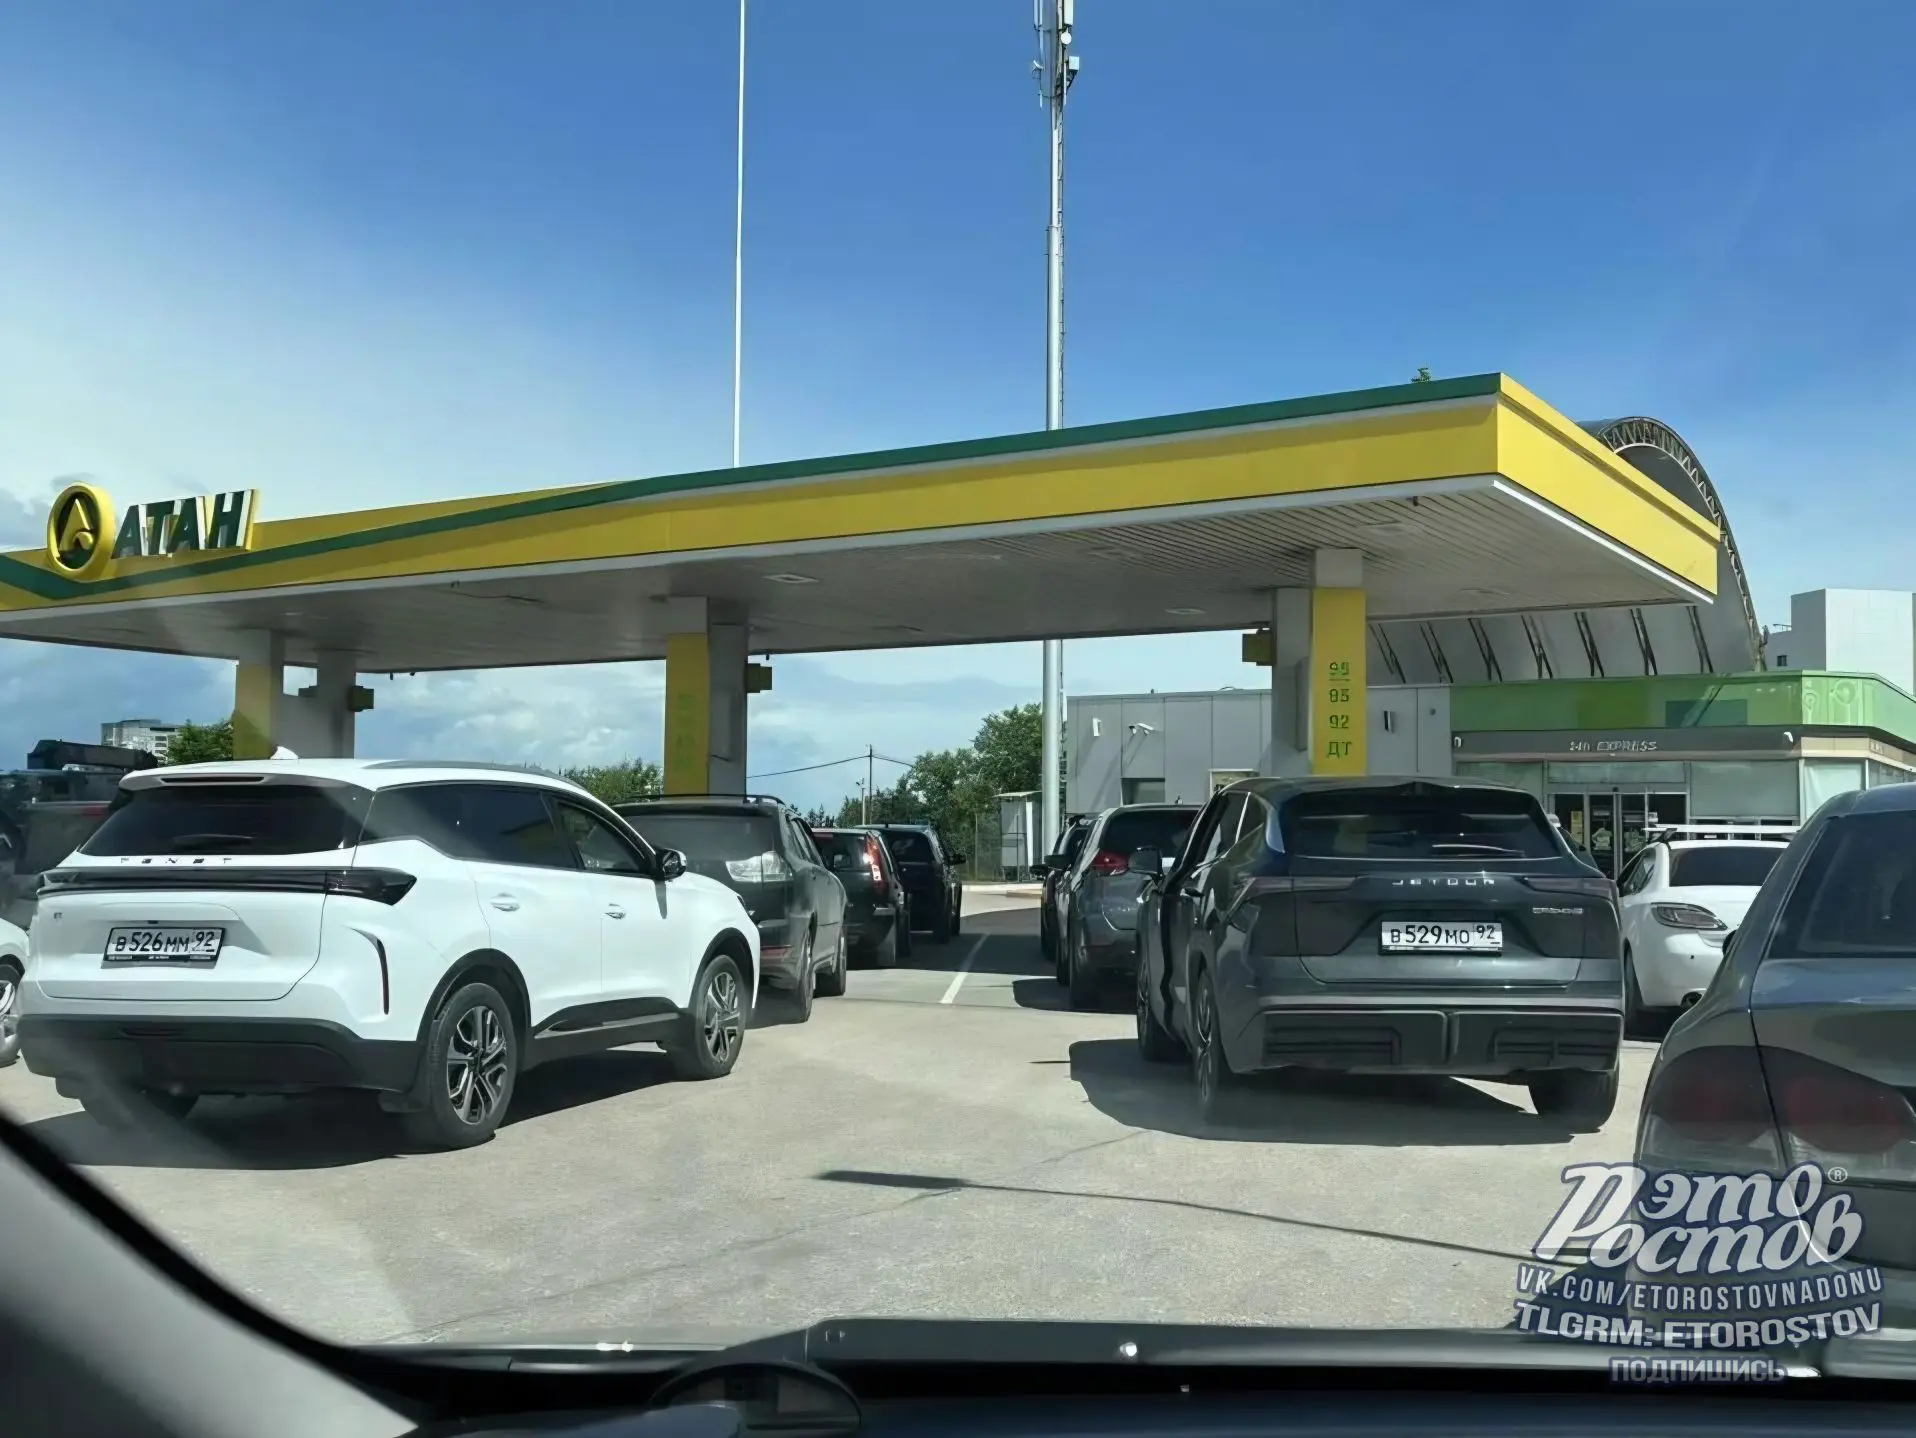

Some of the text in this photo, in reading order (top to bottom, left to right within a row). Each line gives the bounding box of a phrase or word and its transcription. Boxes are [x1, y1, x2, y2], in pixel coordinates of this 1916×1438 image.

[111, 488, 257, 559] АТАН
[1329, 714, 1349, 729] 92
[1327, 741, 1352, 758] ДТ
